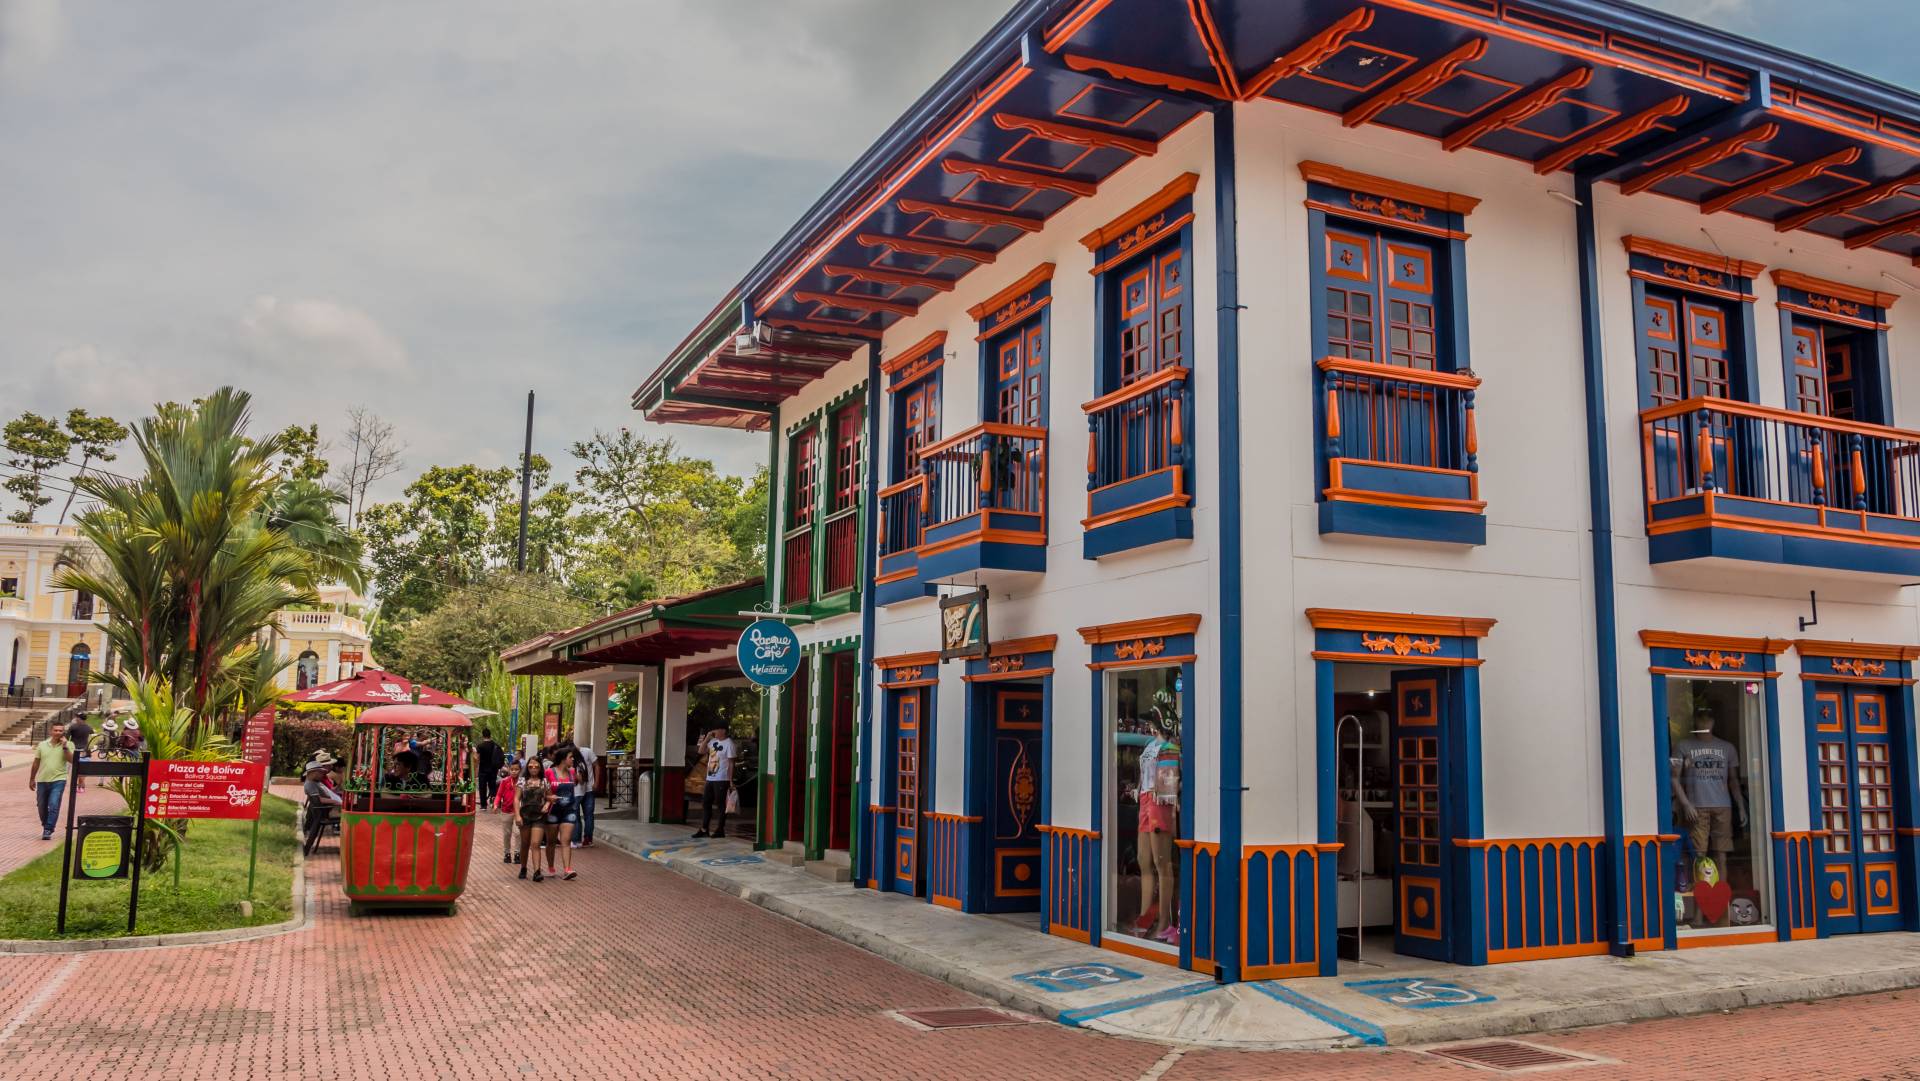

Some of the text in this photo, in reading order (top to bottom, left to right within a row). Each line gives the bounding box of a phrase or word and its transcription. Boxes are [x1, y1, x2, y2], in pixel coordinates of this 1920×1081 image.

[750, 629, 791, 648] Parque
[755, 646, 788, 661] Café
[168, 764, 245, 775] Plaza de Bolívar
[227, 784, 258, 797] Parque
